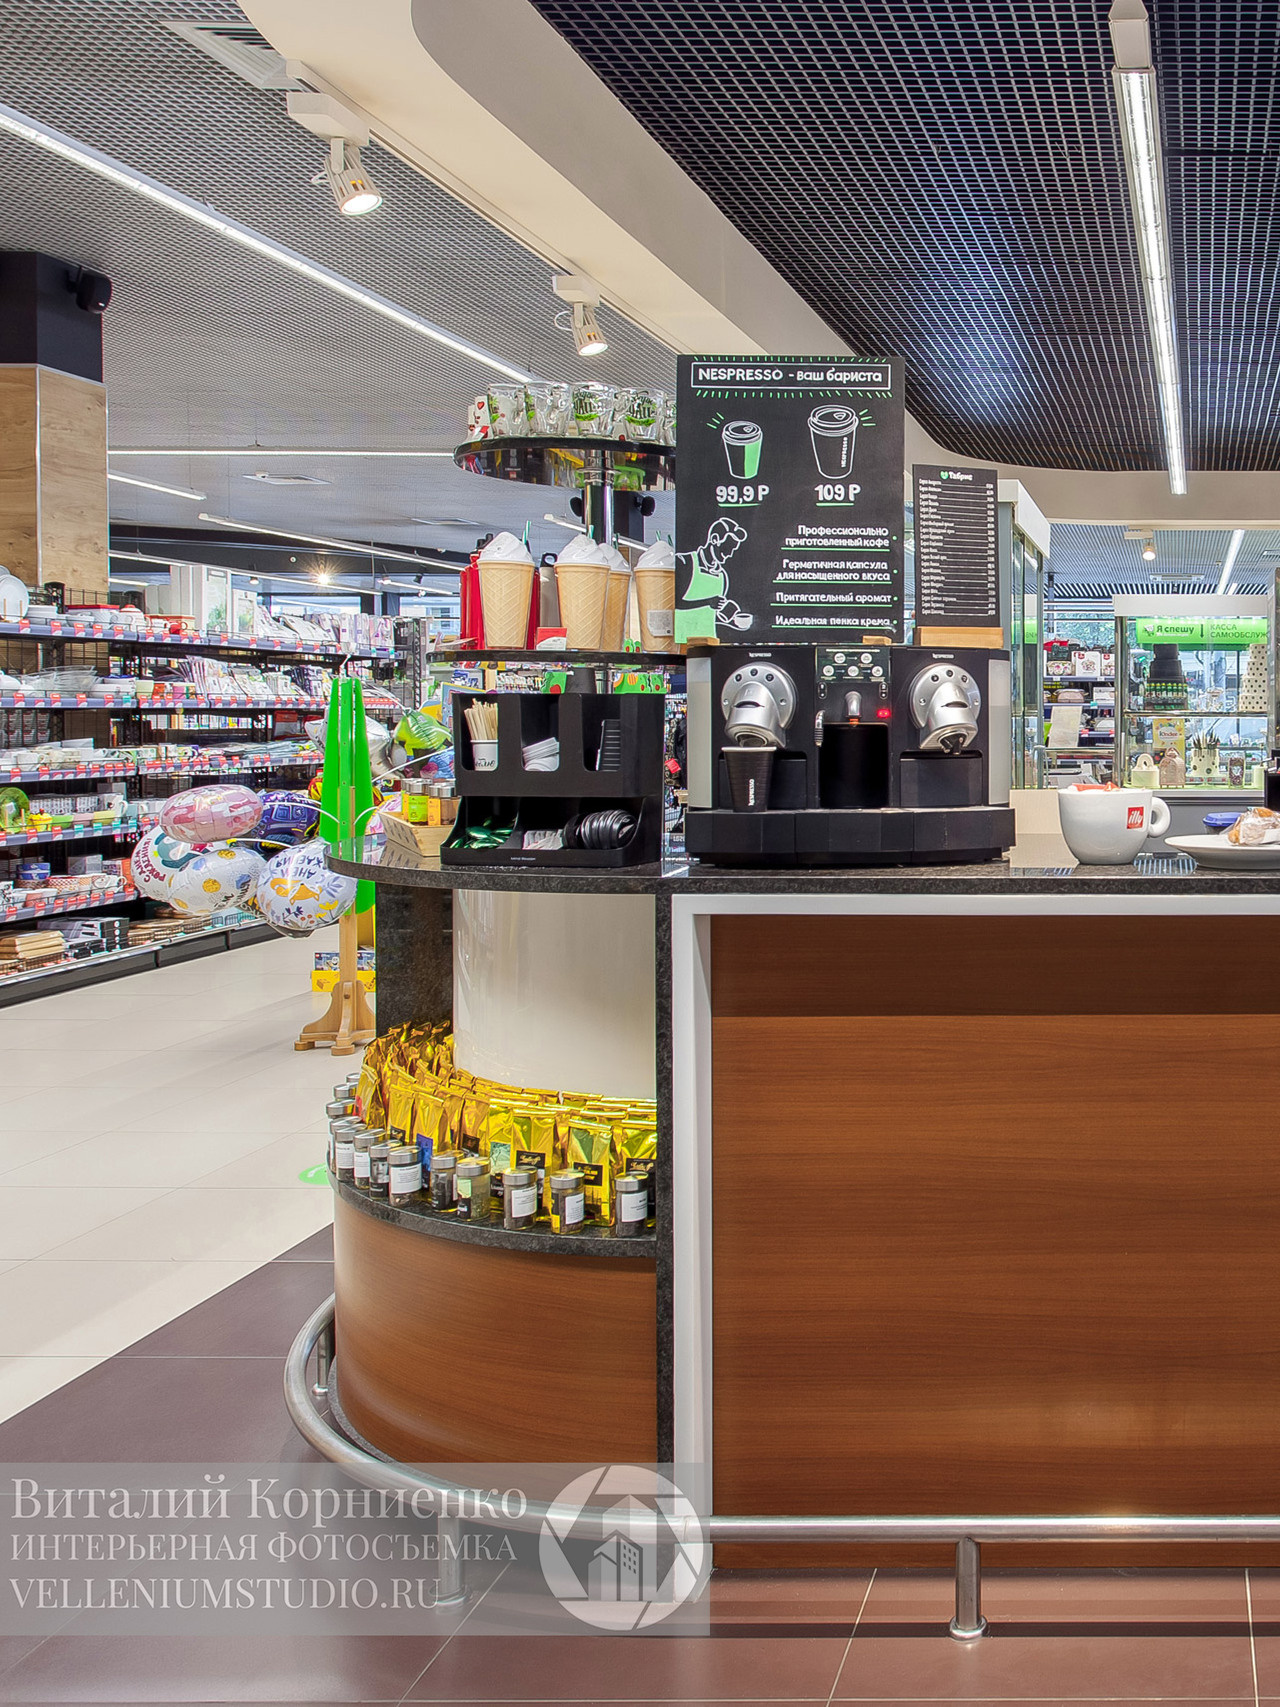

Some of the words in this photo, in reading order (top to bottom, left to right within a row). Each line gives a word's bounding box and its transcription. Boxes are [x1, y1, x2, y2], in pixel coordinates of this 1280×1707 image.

[698, 368, 783, 381] NESPRESSO
[797, 371, 824, 381] ваш
[826, 367, 883, 384] бариста
[716, 485, 755, 504] 99,9
[814, 484, 845, 501] 109
[797, 525, 889, 537] Профессионально
[785, 537, 863, 547] приготовленный
[863, 538, 889, 548] кофе
[782, 559, 846, 570] Герметичная
[846, 560, 888, 570] капсула
[776, 572, 794, 580] для
[795, 572, 860, 581] насыщенного
[861, 573, 890, 581] вкуса
[776, 592, 854, 603] Притягательный
[855, 594, 892, 604] аромат
[775, 615, 827, 625] Идеальная
[1164, 625, 1194, 634] спешу
